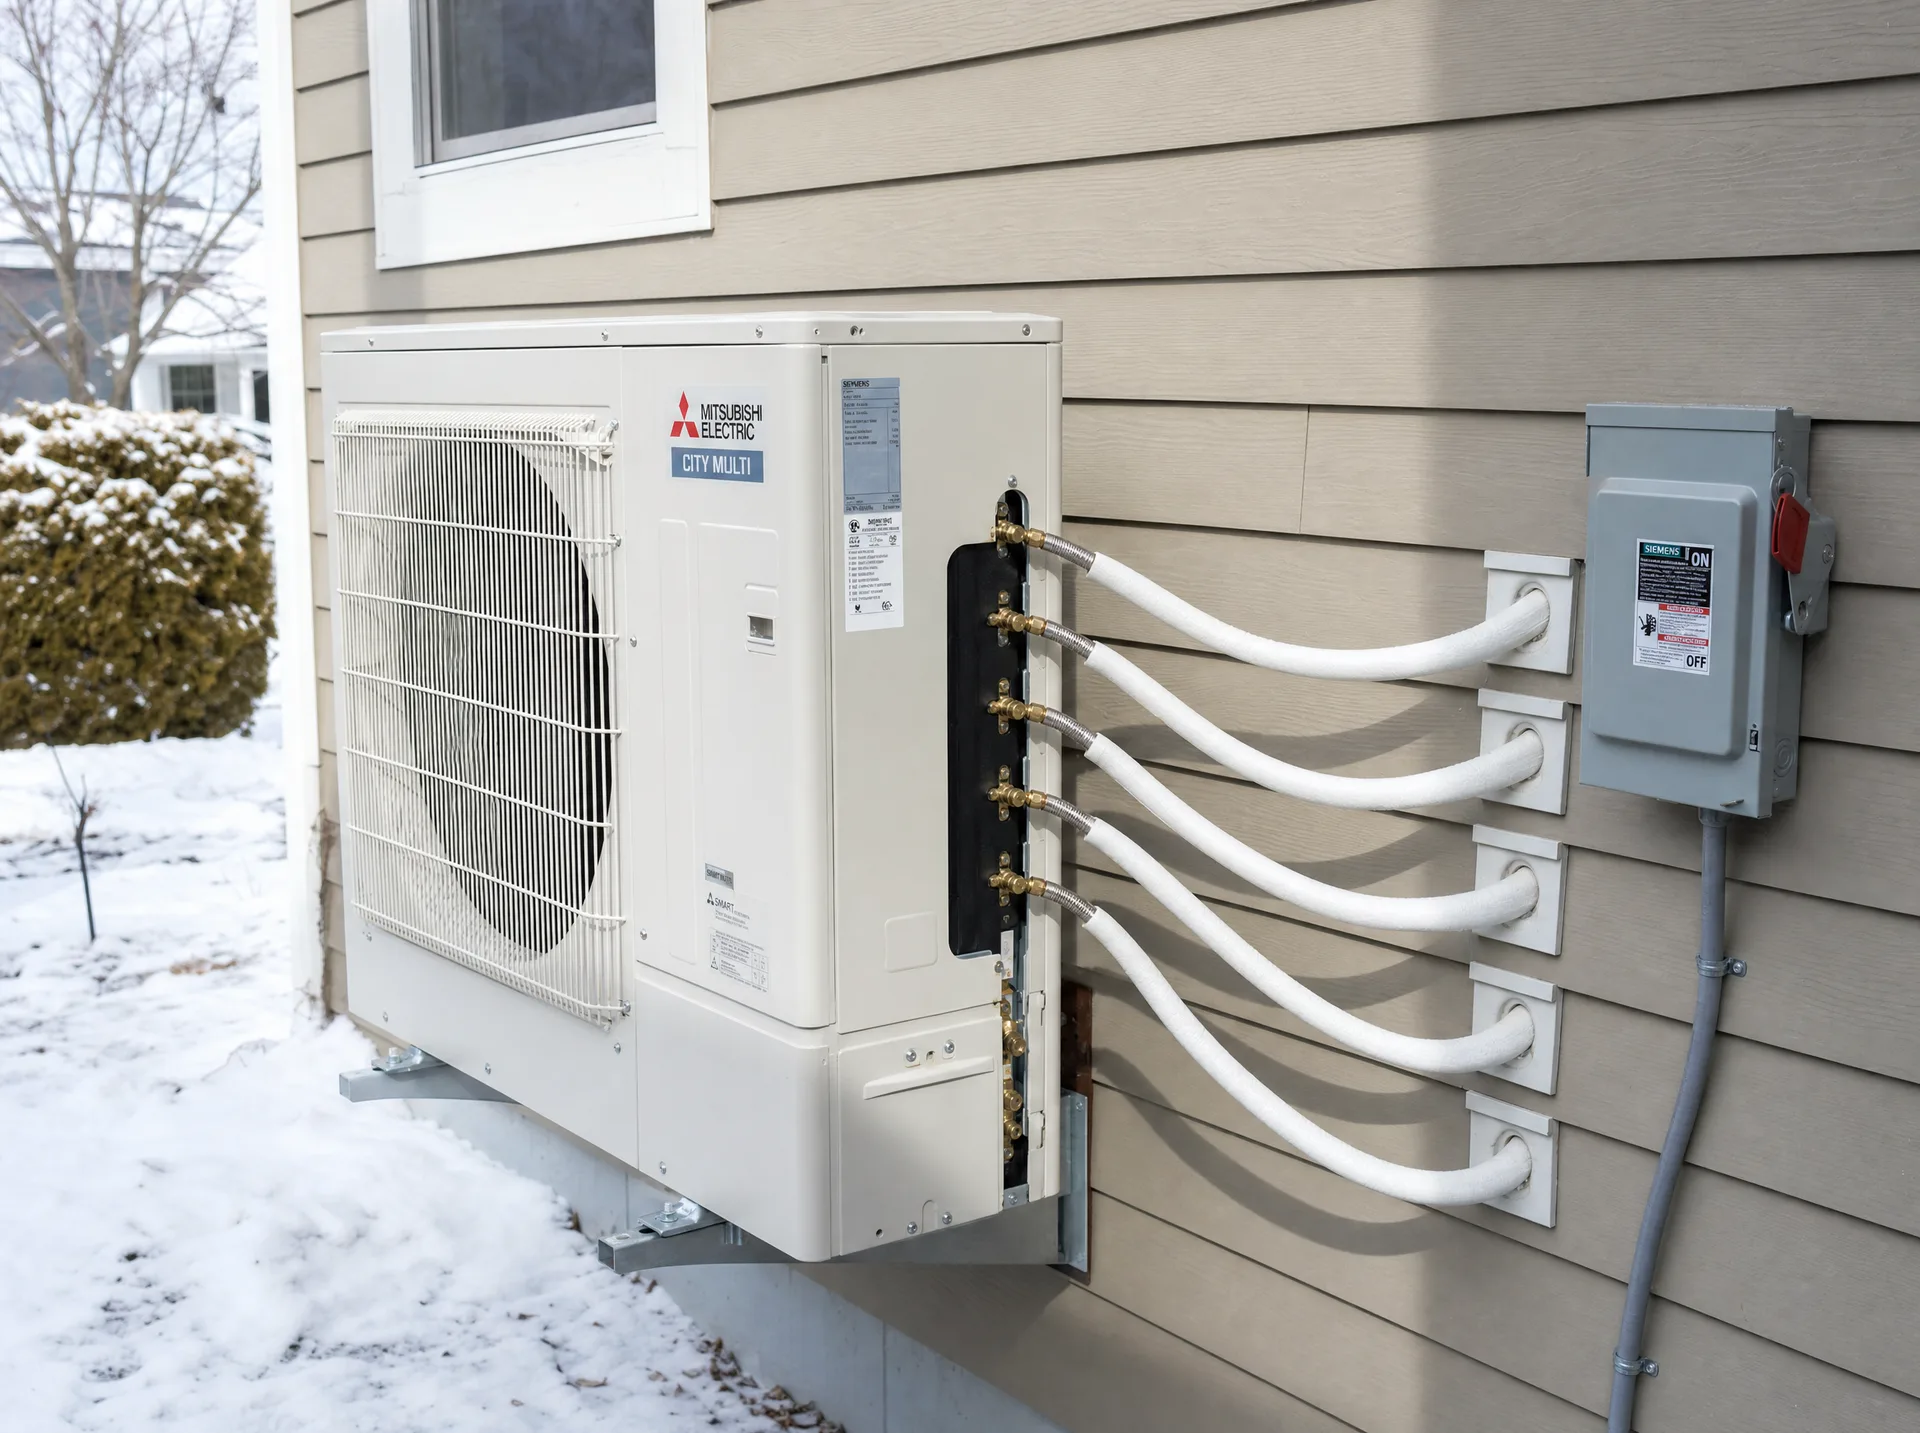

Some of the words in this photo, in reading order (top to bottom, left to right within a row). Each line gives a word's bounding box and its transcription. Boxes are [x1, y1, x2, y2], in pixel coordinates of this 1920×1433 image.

[701, 404, 763, 421] MITSUBISHI
[702, 422, 755, 440] ELECTRIC
[683, 454, 709, 473] CITY
[712, 456, 751, 475] MULTI
[1644, 545, 1680, 556] SIEMENS
[1691, 552, 1710, 567] ON
[1686, 655, 1707, 669] OFF
[714, 898, 734, 914] SMART
